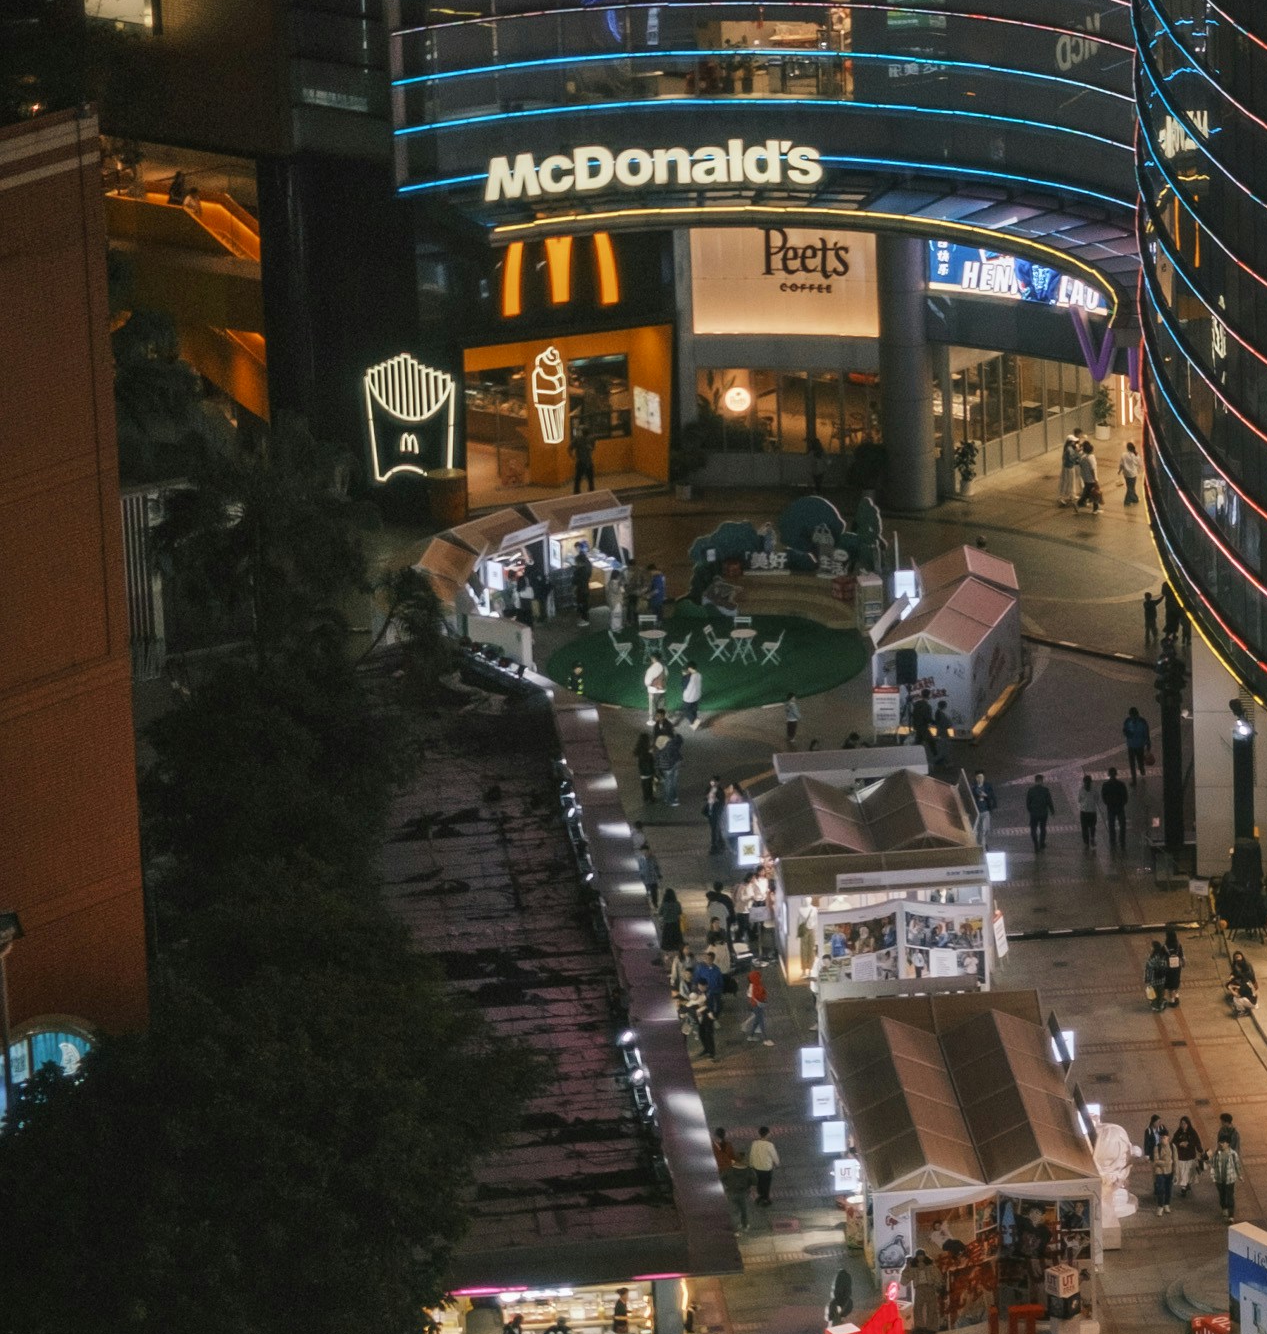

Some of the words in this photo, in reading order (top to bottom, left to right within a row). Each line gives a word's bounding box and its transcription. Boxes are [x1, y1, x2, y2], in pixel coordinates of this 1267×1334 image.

[485, 138, 824, 201] McDonald's
[759, 229, 850, 279] Peet's
[779, 282, 833, 293] COFFEE
[1058, 275, 1100, 310] LAU
